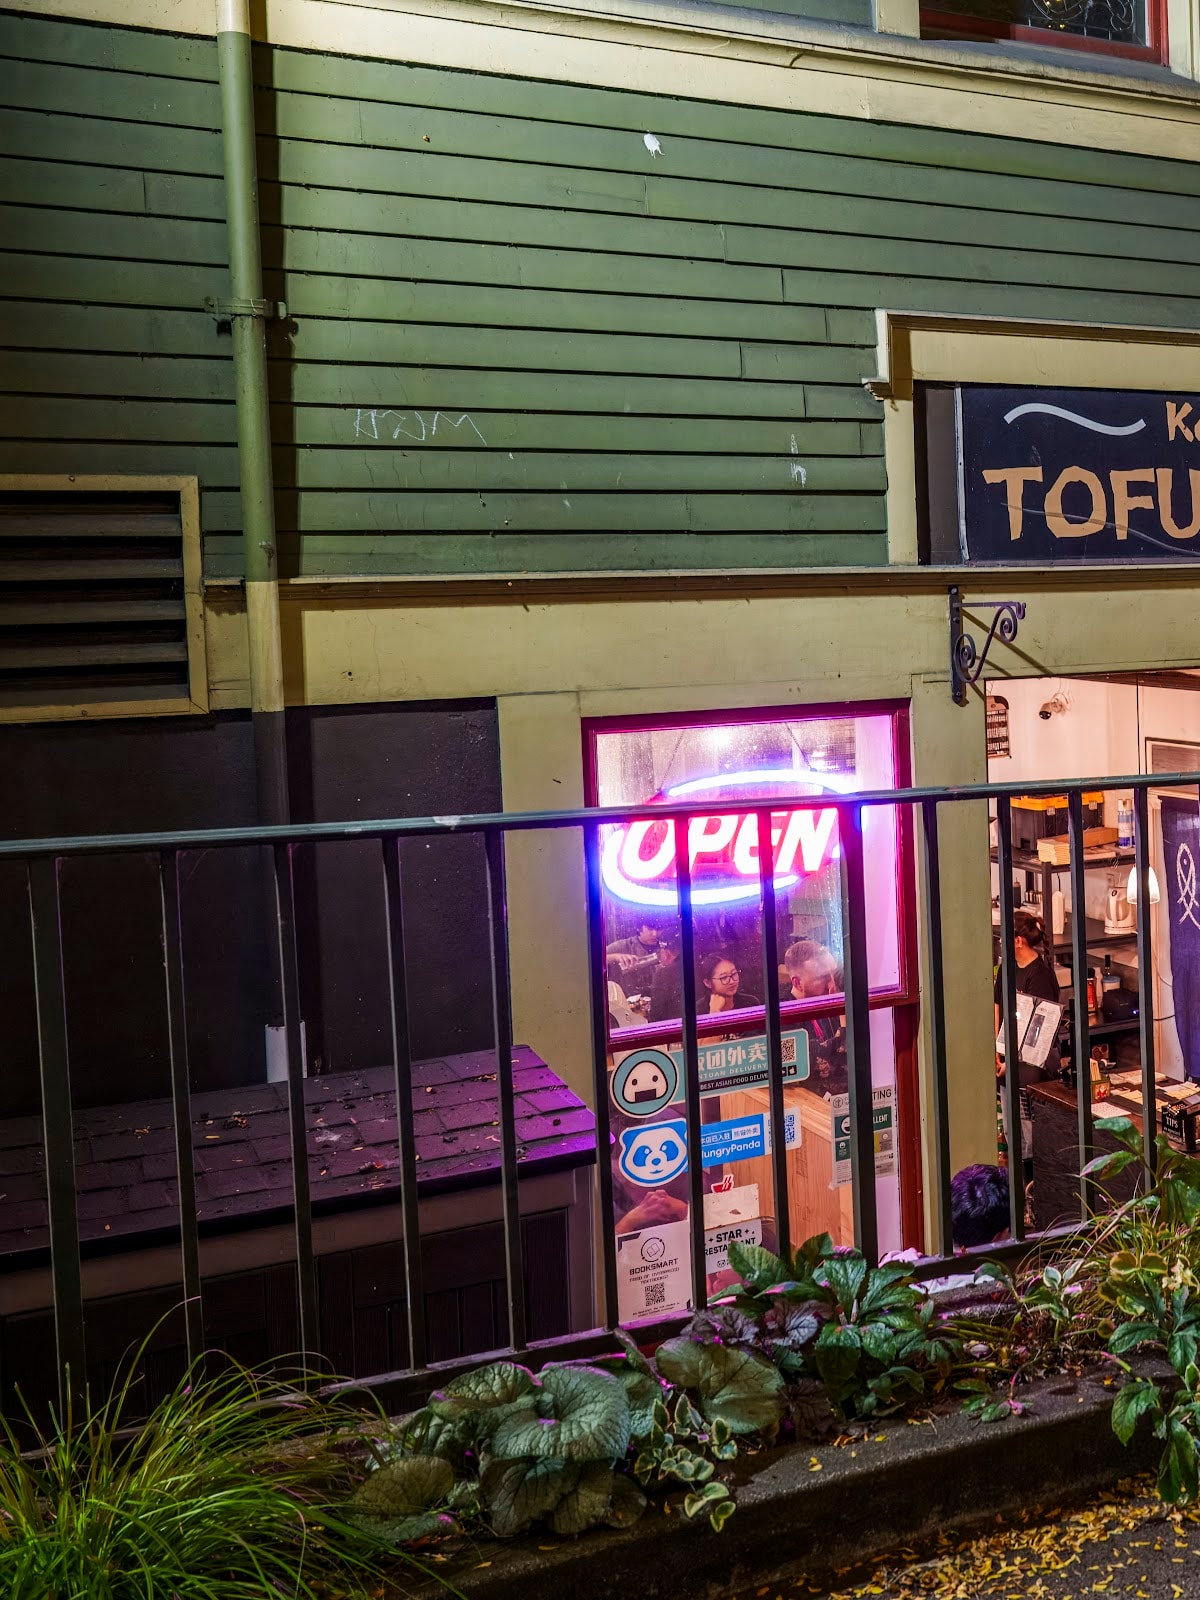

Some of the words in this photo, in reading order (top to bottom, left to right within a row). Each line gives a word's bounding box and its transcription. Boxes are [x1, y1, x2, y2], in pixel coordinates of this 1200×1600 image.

[620, 807, 839, 881] OPEN
[698, 1071, 726, 1081] NTUAN
[729, 1063, 768, 1076] DELIVERY
[715, 1079, 732, 1089] ASIAN
[733, 1076, 749, 1086] FOOD
[750, 1073, 768, 1083] DELIVE
[872, 1089, 892, 1102] TING
[1165, 1116, 1179, 1129] TIPS
[716, 1229, 742, 1243] STAR
[629, 1258, 679, 1276] BOOKSMART
